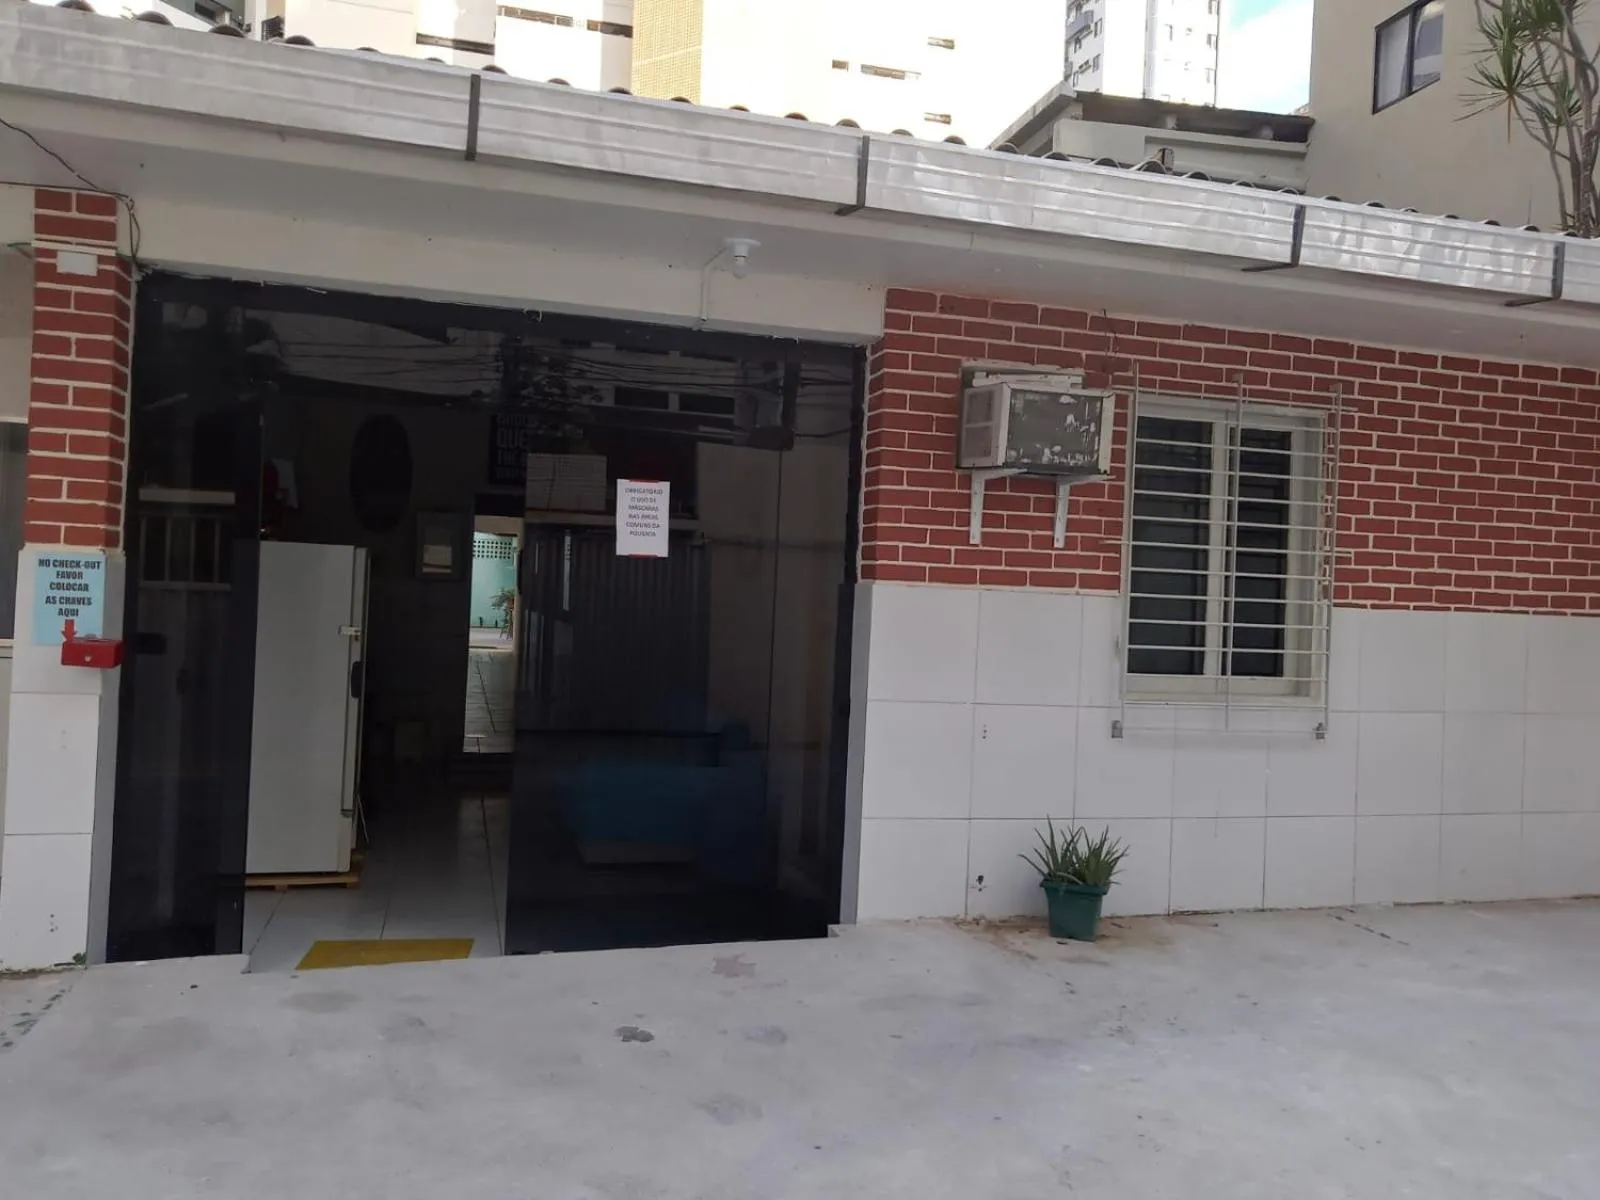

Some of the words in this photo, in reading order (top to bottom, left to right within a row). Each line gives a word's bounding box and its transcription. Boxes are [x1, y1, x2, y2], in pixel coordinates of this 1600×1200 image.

[38, 559, 50, 568] NO
[52, 559, 102, 570] CHECK-OUT
[56, 570, 83, 580] FAVOR
[49, 582, 89, 592] COLOCAR
[45, 596, 57, 605] AS
[58, 596, 92, 606] CHAVES
[58, 608, 79, 617] AQUI
